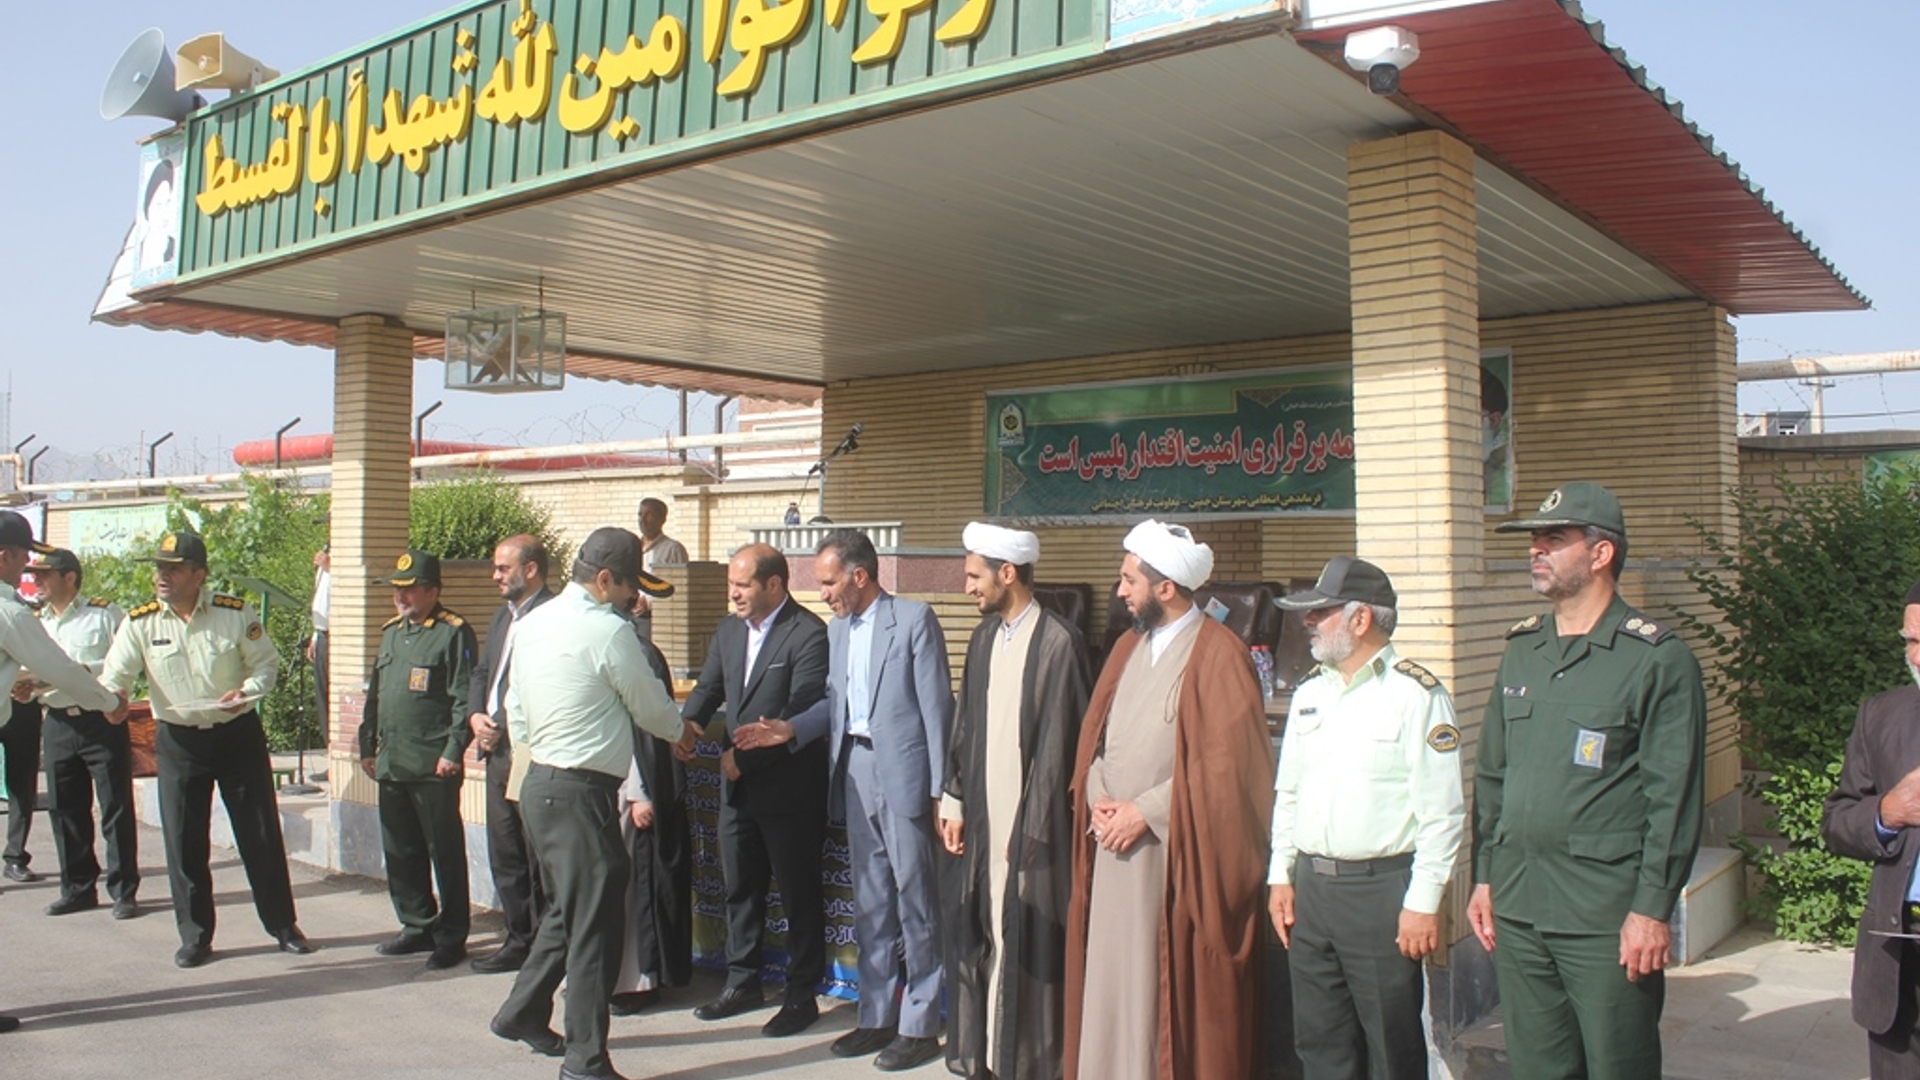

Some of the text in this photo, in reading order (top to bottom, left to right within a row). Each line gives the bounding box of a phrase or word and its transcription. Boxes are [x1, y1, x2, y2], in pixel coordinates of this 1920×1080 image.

[1039, 435, 1079, 473] است
[1078, 432, 1128, 481] پلیس
[1126, 427, 1184, 480] اقتدار
[1185, 425, 1242, 475] امنیت
